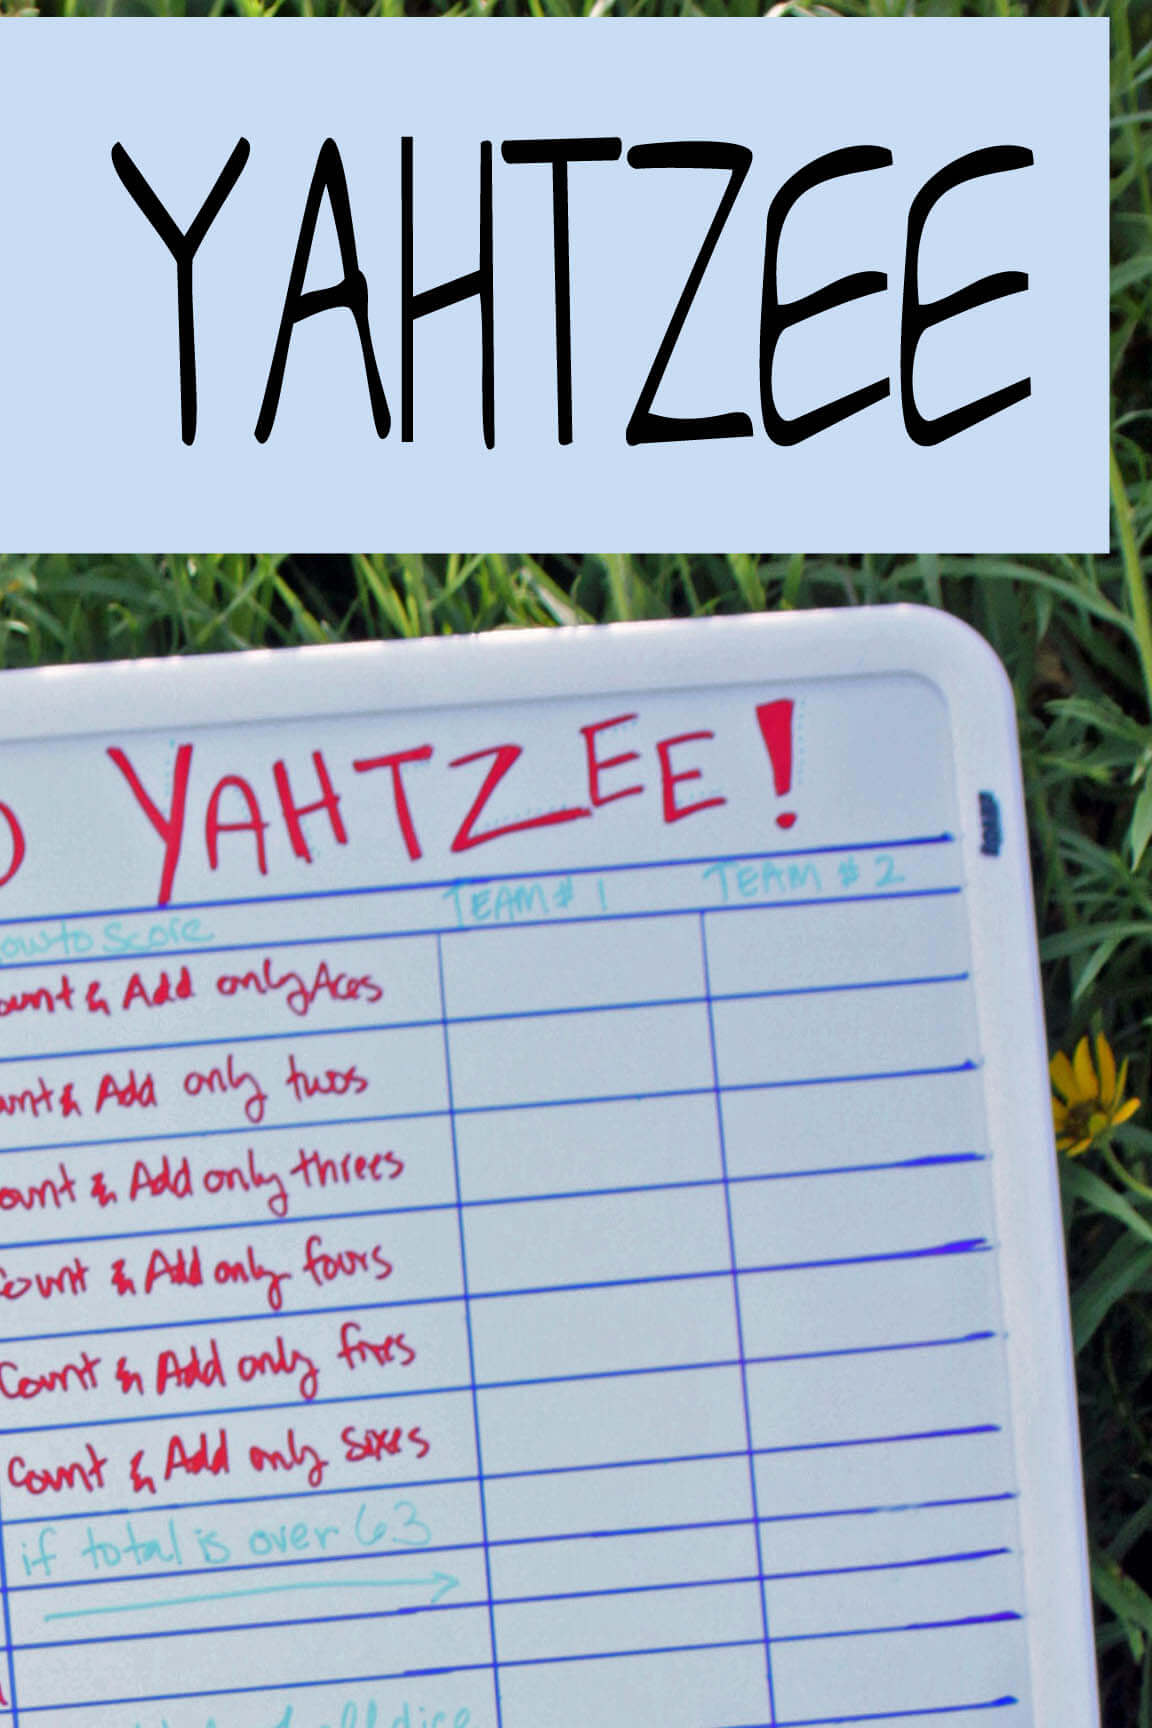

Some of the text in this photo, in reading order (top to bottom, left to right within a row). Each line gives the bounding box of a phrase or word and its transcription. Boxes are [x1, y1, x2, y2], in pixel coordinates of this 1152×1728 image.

[443, 880, 546, 928] TEAM
[702, 854, 820, 903] TEAM
[101, 916, 216, 955] Score
[122, 965, 195, 1010] Add
[216, 958, 312, 1017] only
[95, 1069, 158, 1113] Add
[183, 1053, 268, 1124] only
[285, 1054, 369, 1102] twos
[129, 1155, 193, 1200] Add
[203, 1148, 288, 1217] only
[290, 1148, 405, 1187] threes
[145, 1245, 203, 1294] Add
[214, 1246, 292, 1311] only
[304, 1235, 393, 1286] fours
[156, 1338, 227, 1396] Add
[237, 1337, 319, 1401] only
[9, 1442, 108, 1494] Count
[164, 1428, 231, 1480] Add
[249, 1428, 328, 1488] only
[21, 1500, 432, 1576] if total is over 63
